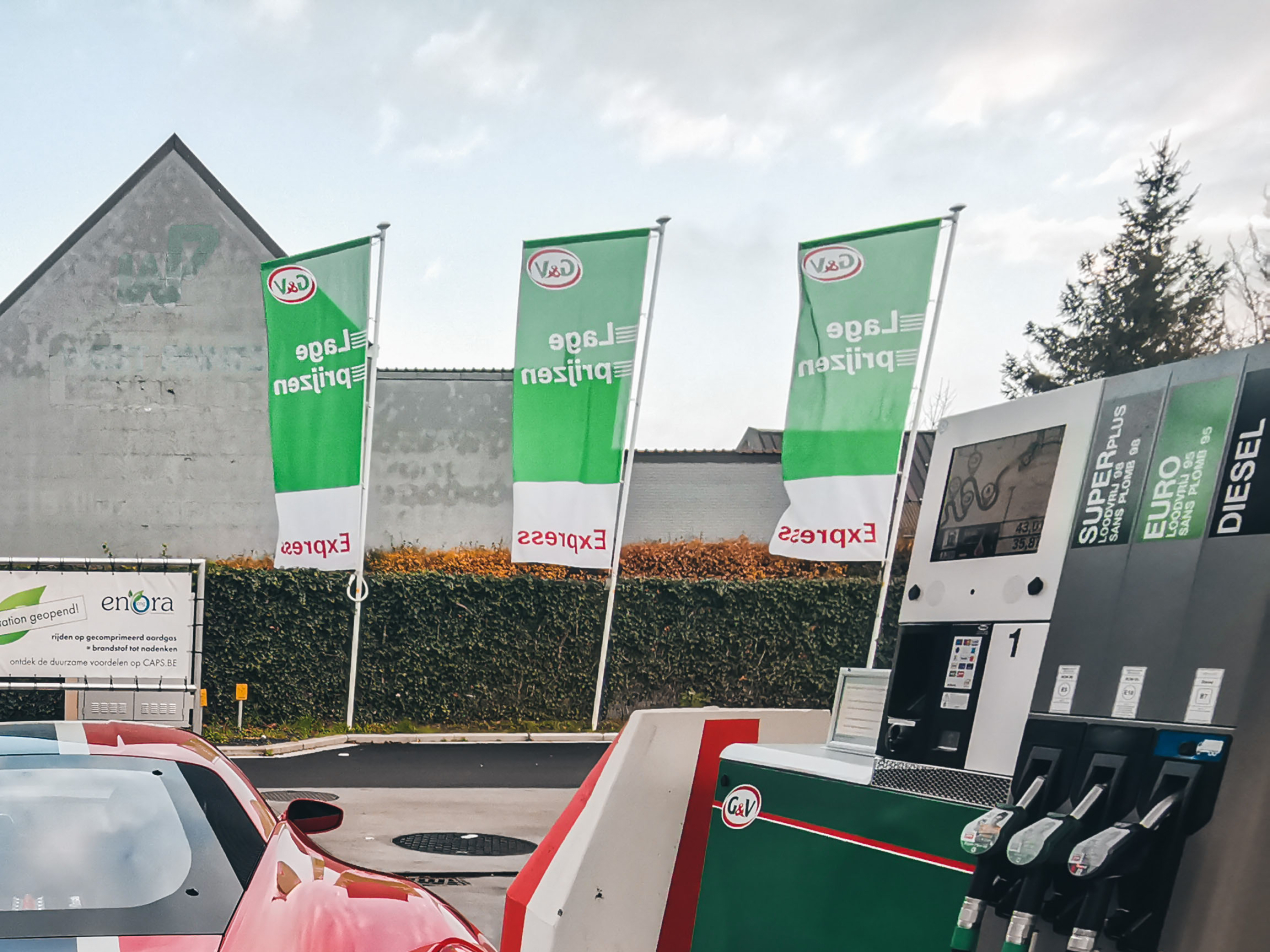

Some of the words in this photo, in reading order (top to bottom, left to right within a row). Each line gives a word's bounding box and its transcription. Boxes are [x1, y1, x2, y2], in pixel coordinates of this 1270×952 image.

[1183, 451, 1195, 469] 95
[1178, 500, 1195, 536] SANS
[1200, 426, 1213, 445] 95
[1217, 417, 1267, 534] DIESEL
[1109, 508, 1124, 542] SANS
[1118, 460, 1136, 504] PLOMB
[1143, 455, 1181, 540] EURO
[30, 603, 80, 624] geopend!
[101, 594, 174, 613] enora
[51, 633, 73, 642] rijden
[74, 635, 85, 643] op
[86, 634, 144, 643] gecomprimeerd
[145, 634, 177, 643] aardgas
[1008, 628, 1022, 658] 1
[9, 657, 36, 666] ontdek
[38, 658, 48, 666] de
[49, 658, 88, 667] duurzame
[89, 659, 128, 667] voordelen
[130, 660, 141, 669] op
[142, 659, 177, 667] CAPS.BE
[733, 797, 756, 817] G&V
